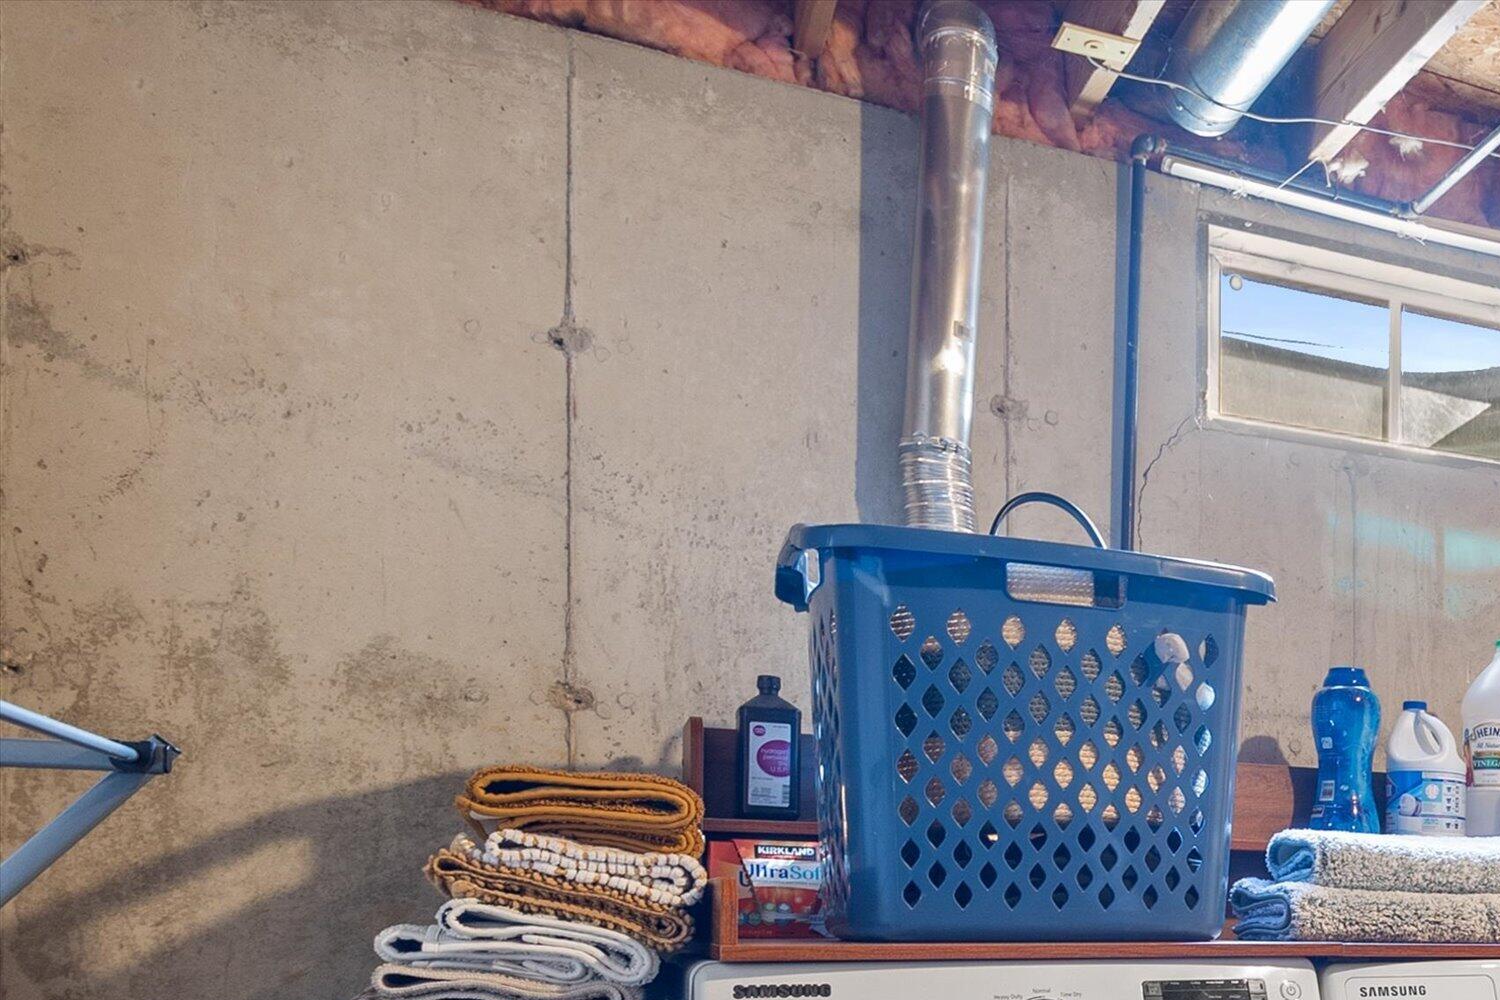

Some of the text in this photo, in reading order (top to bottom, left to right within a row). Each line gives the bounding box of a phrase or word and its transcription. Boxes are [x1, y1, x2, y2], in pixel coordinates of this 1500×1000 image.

[757, 845, 815, 857] KIRKLAND
[739, 863, 822, 887] UltraSof
[733, 984, 831, 999] SAMSUNG
[1360, 985, 1426, 997] SAMSUNG
